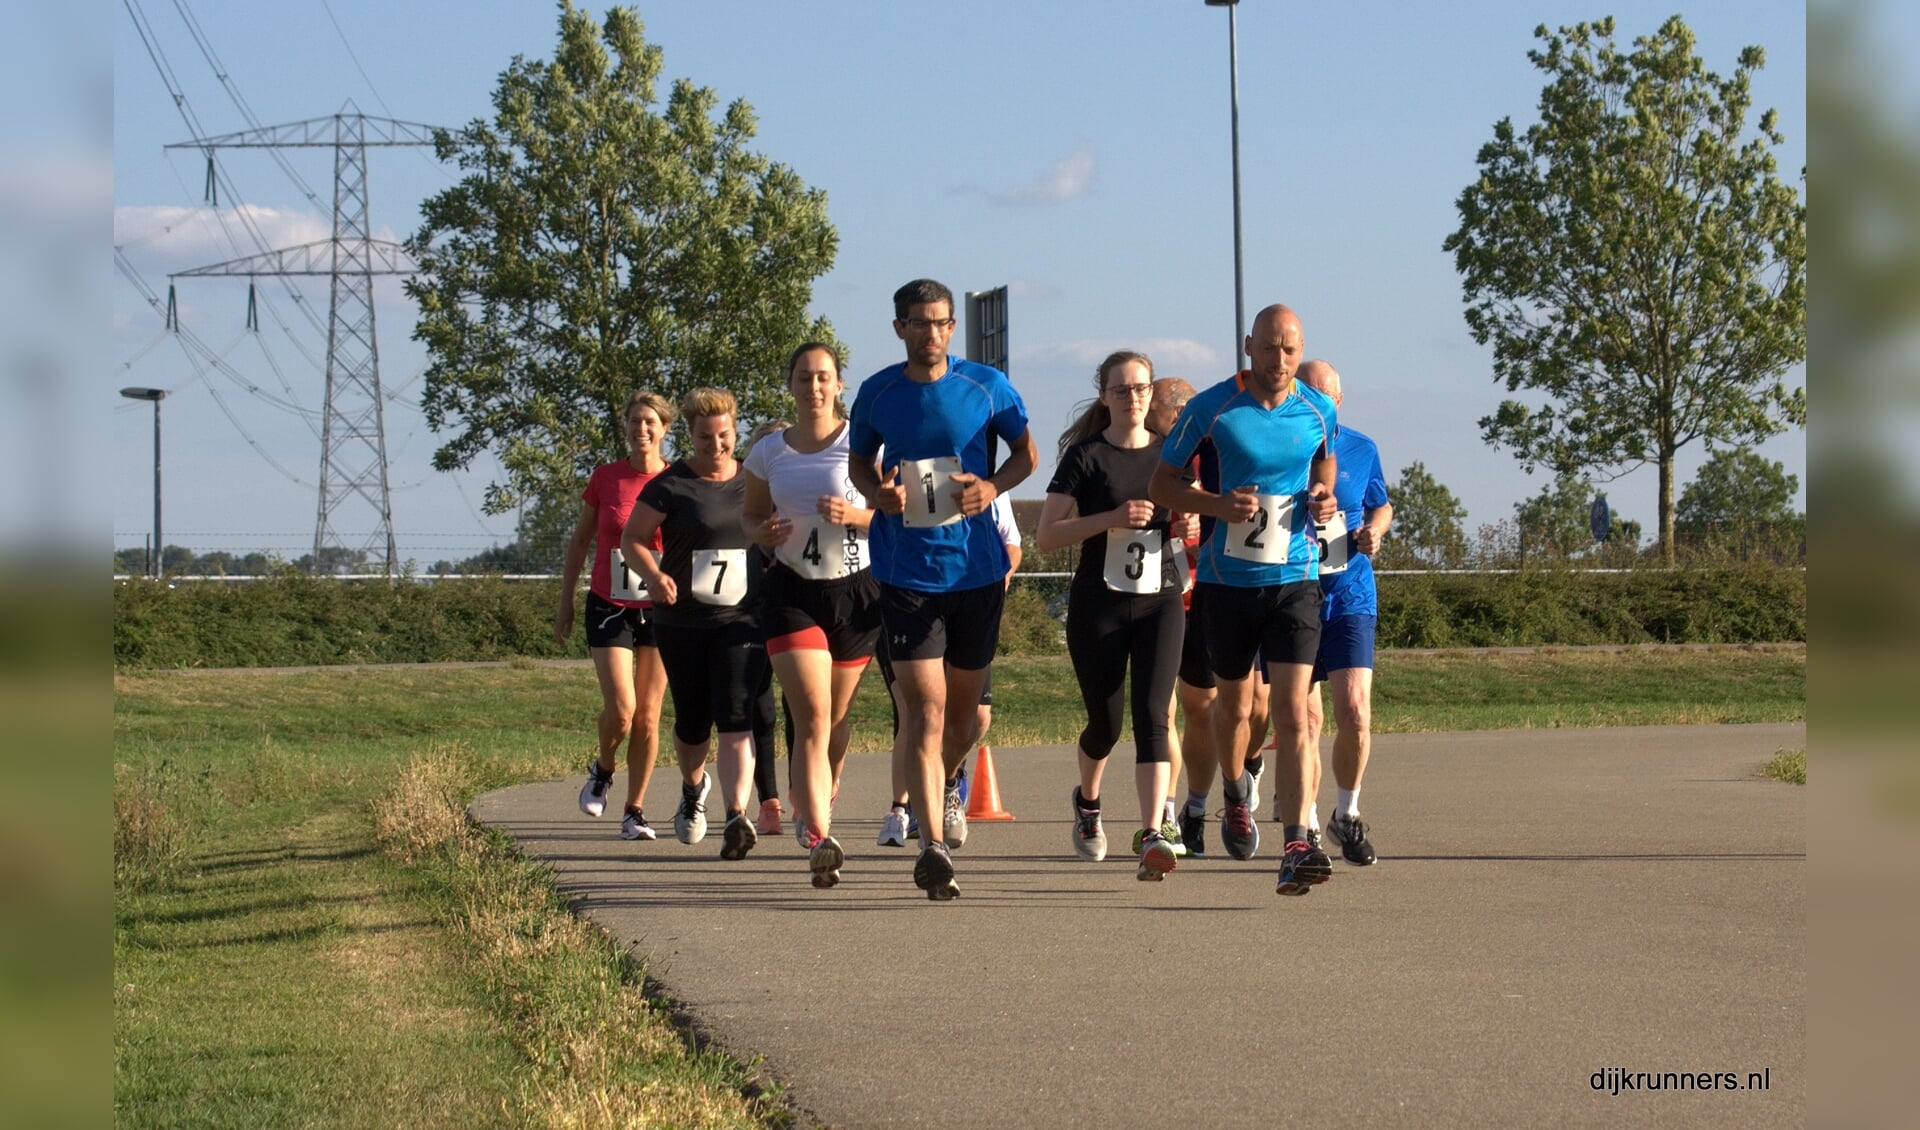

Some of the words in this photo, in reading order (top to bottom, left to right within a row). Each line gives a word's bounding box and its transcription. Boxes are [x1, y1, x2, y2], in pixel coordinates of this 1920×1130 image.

[921, 472, 936, 514] 1
[803, 527, 822, 566] 4
[1244, 506, 1268, 549] 2
[711, 561, 728, 594] 7
[1125, 542, 1146, 580] 3
